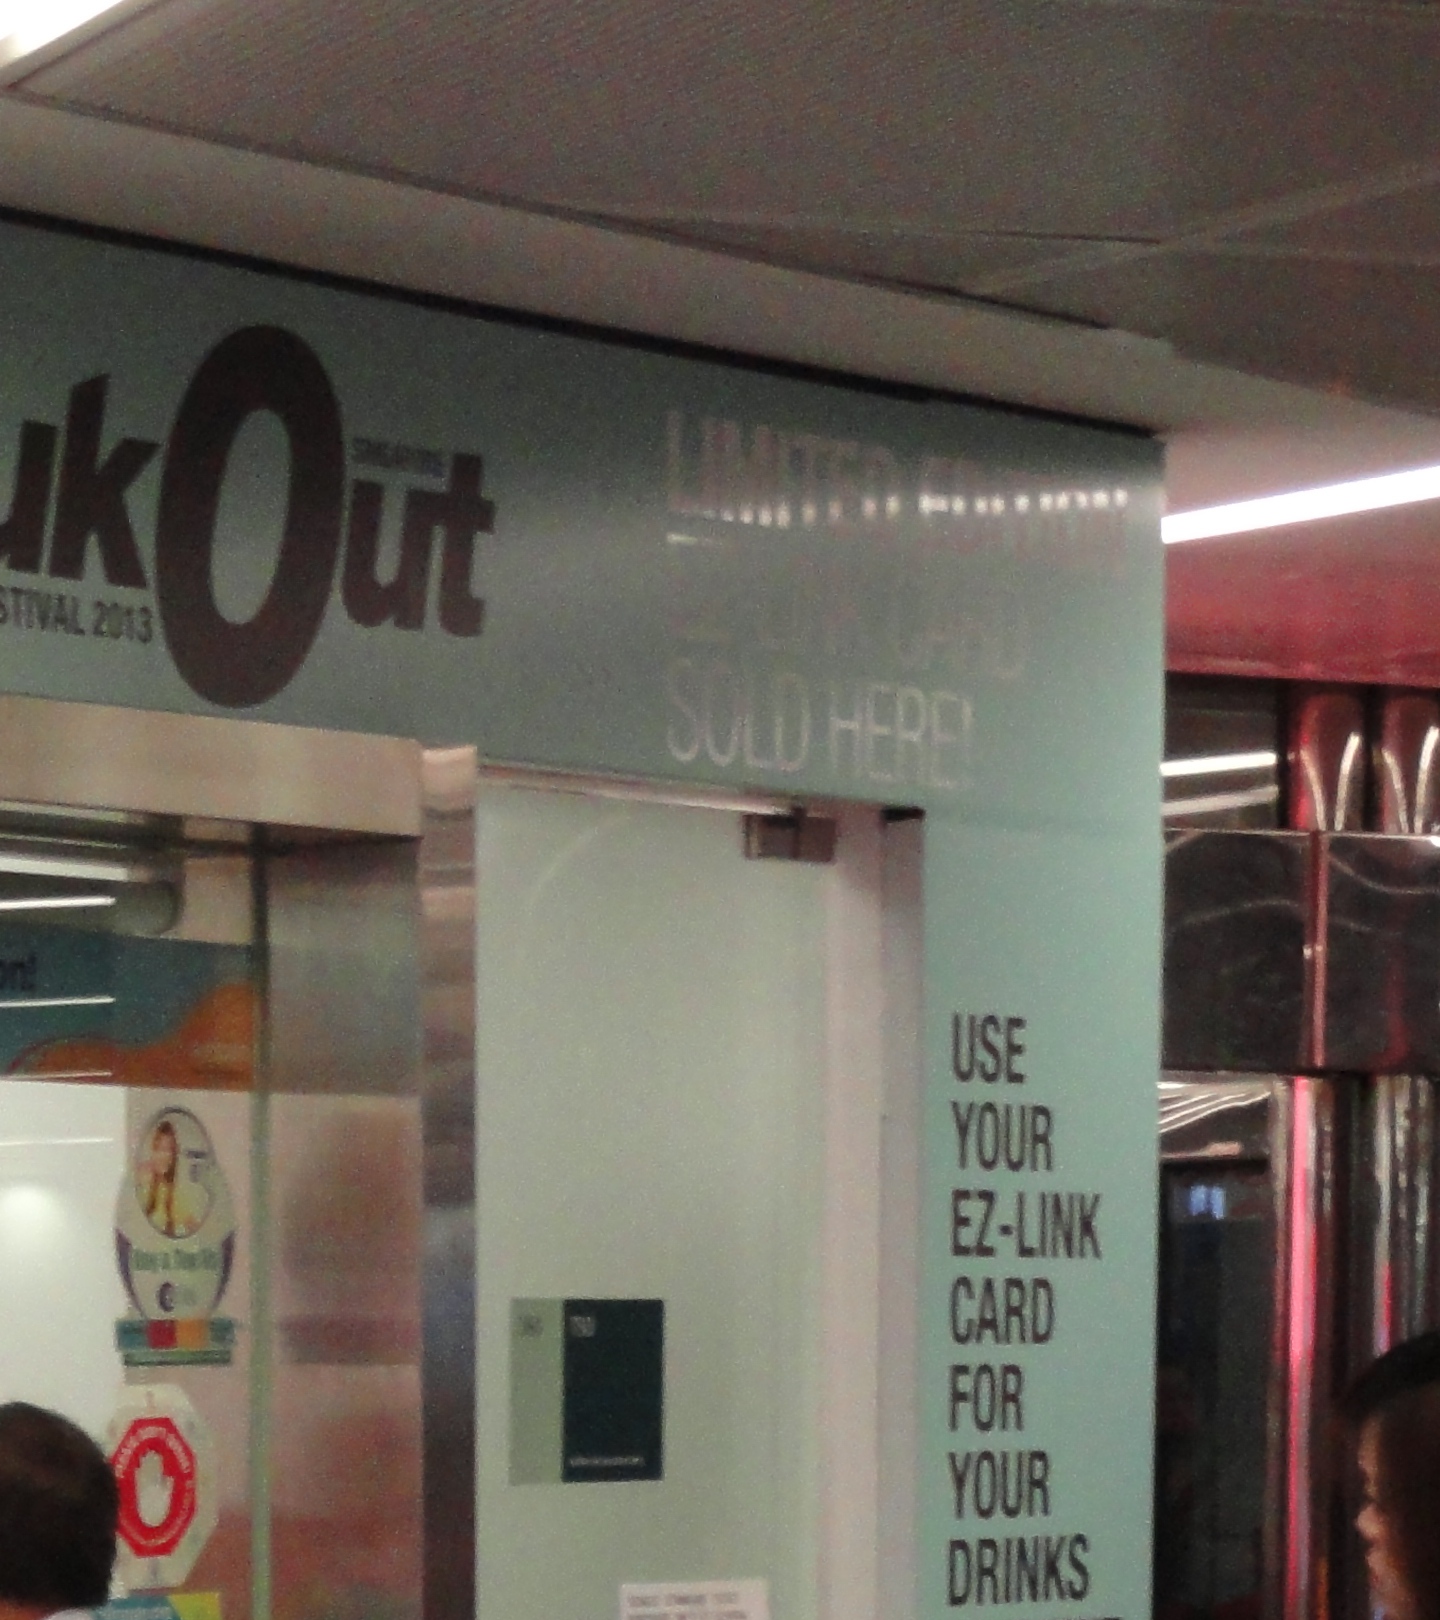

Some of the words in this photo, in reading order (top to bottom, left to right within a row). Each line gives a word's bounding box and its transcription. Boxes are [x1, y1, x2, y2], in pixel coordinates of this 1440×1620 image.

[91, 599, 155, 645] 2013
[951, 1013, 1027, 1085] USE
[950, 1100, 1055, 1173] YOUR
[949, 1187, 1103, 1260] EZ-LINK
[949, 1275, 1056, 1346] CARD
[947, 1363, 1025, 1433] FOR
[947, 1449, 1051, 1521] YOUR
[946, 1532, 1091, 1607] DRINKS
